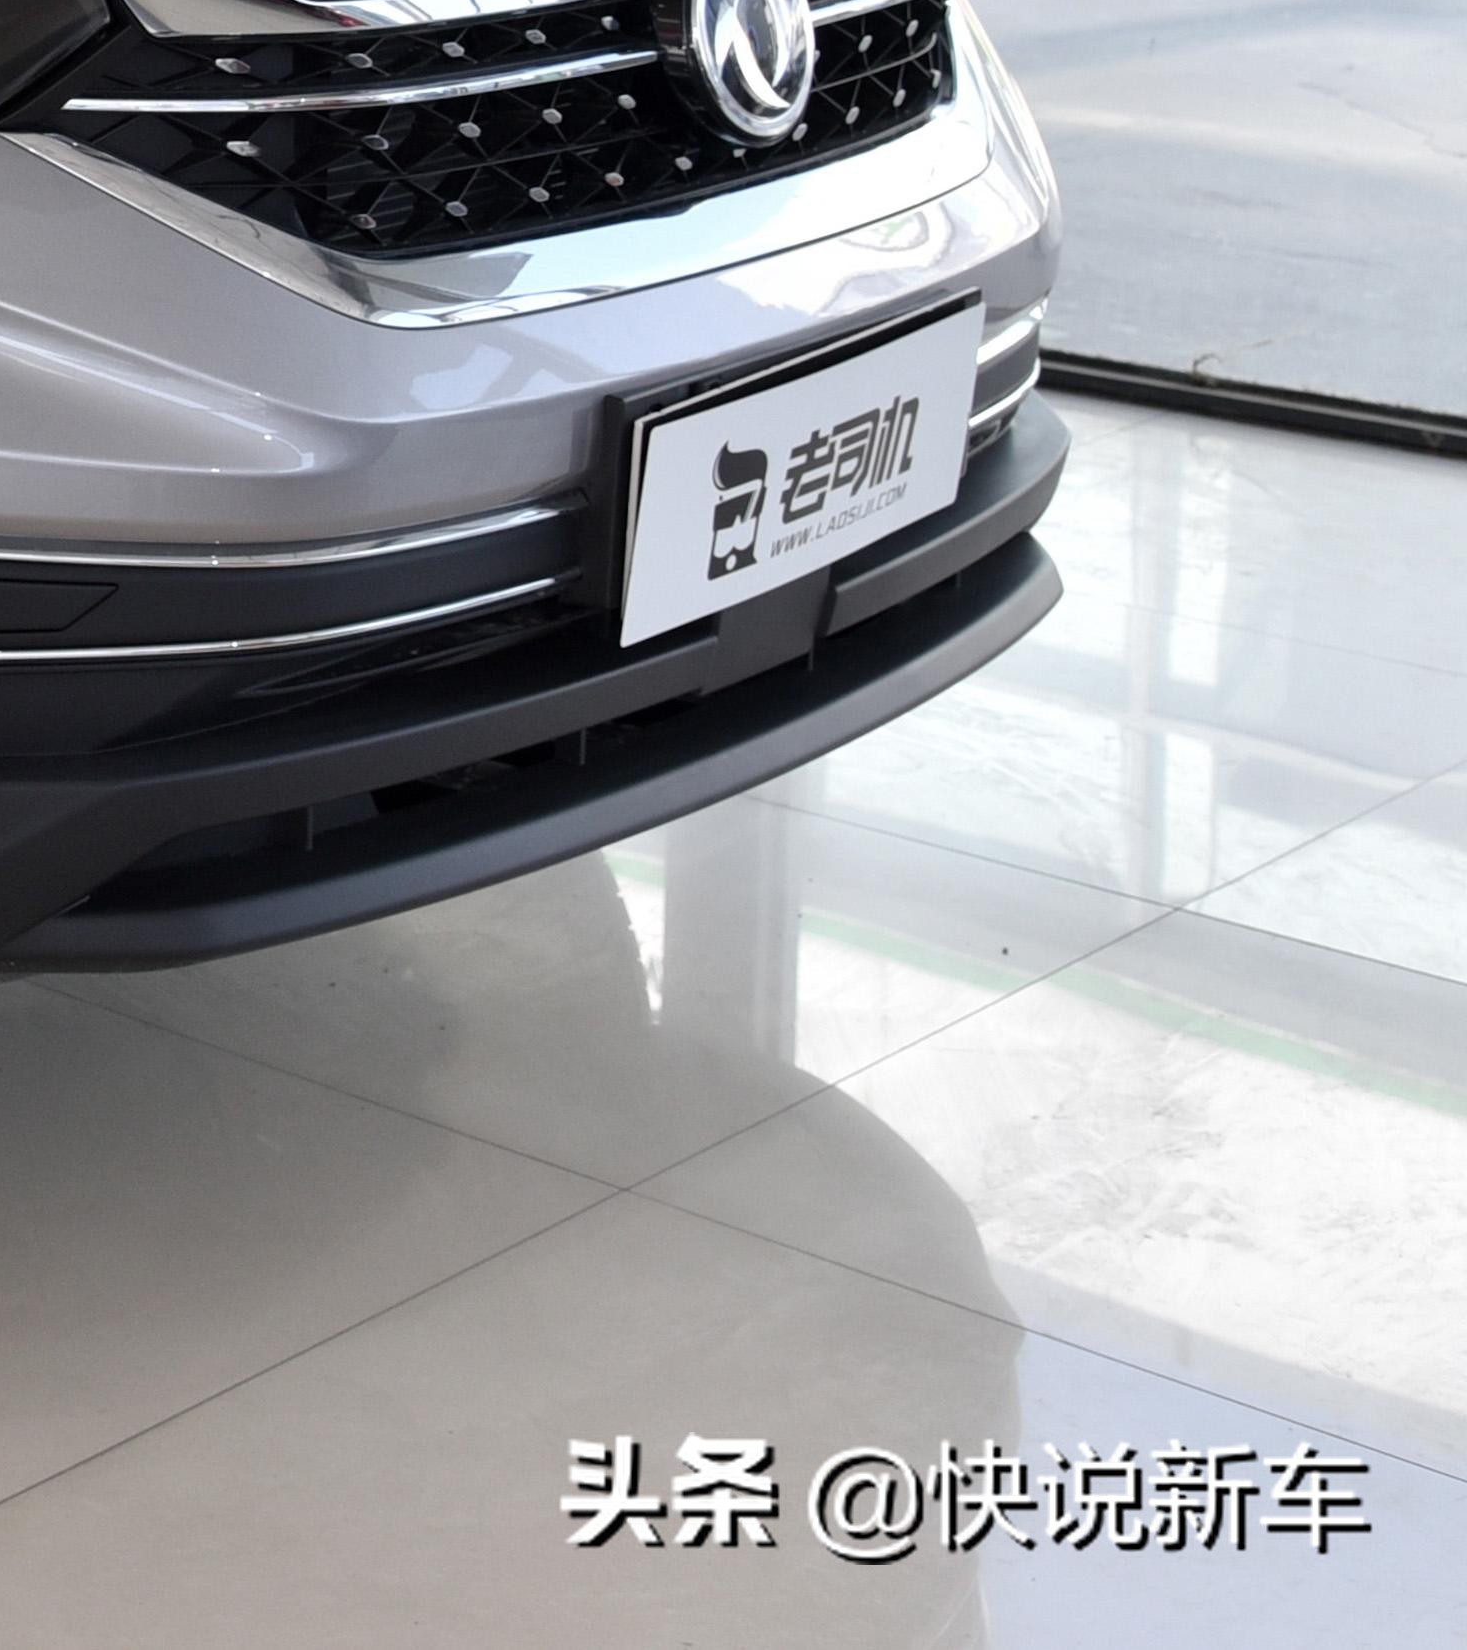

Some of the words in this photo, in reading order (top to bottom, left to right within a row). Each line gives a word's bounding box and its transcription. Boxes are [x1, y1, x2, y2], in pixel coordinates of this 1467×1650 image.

[779, 396, 920, 524] 老司机
[769, 482, 907, 558] WWW.LAOSIJI.COM
